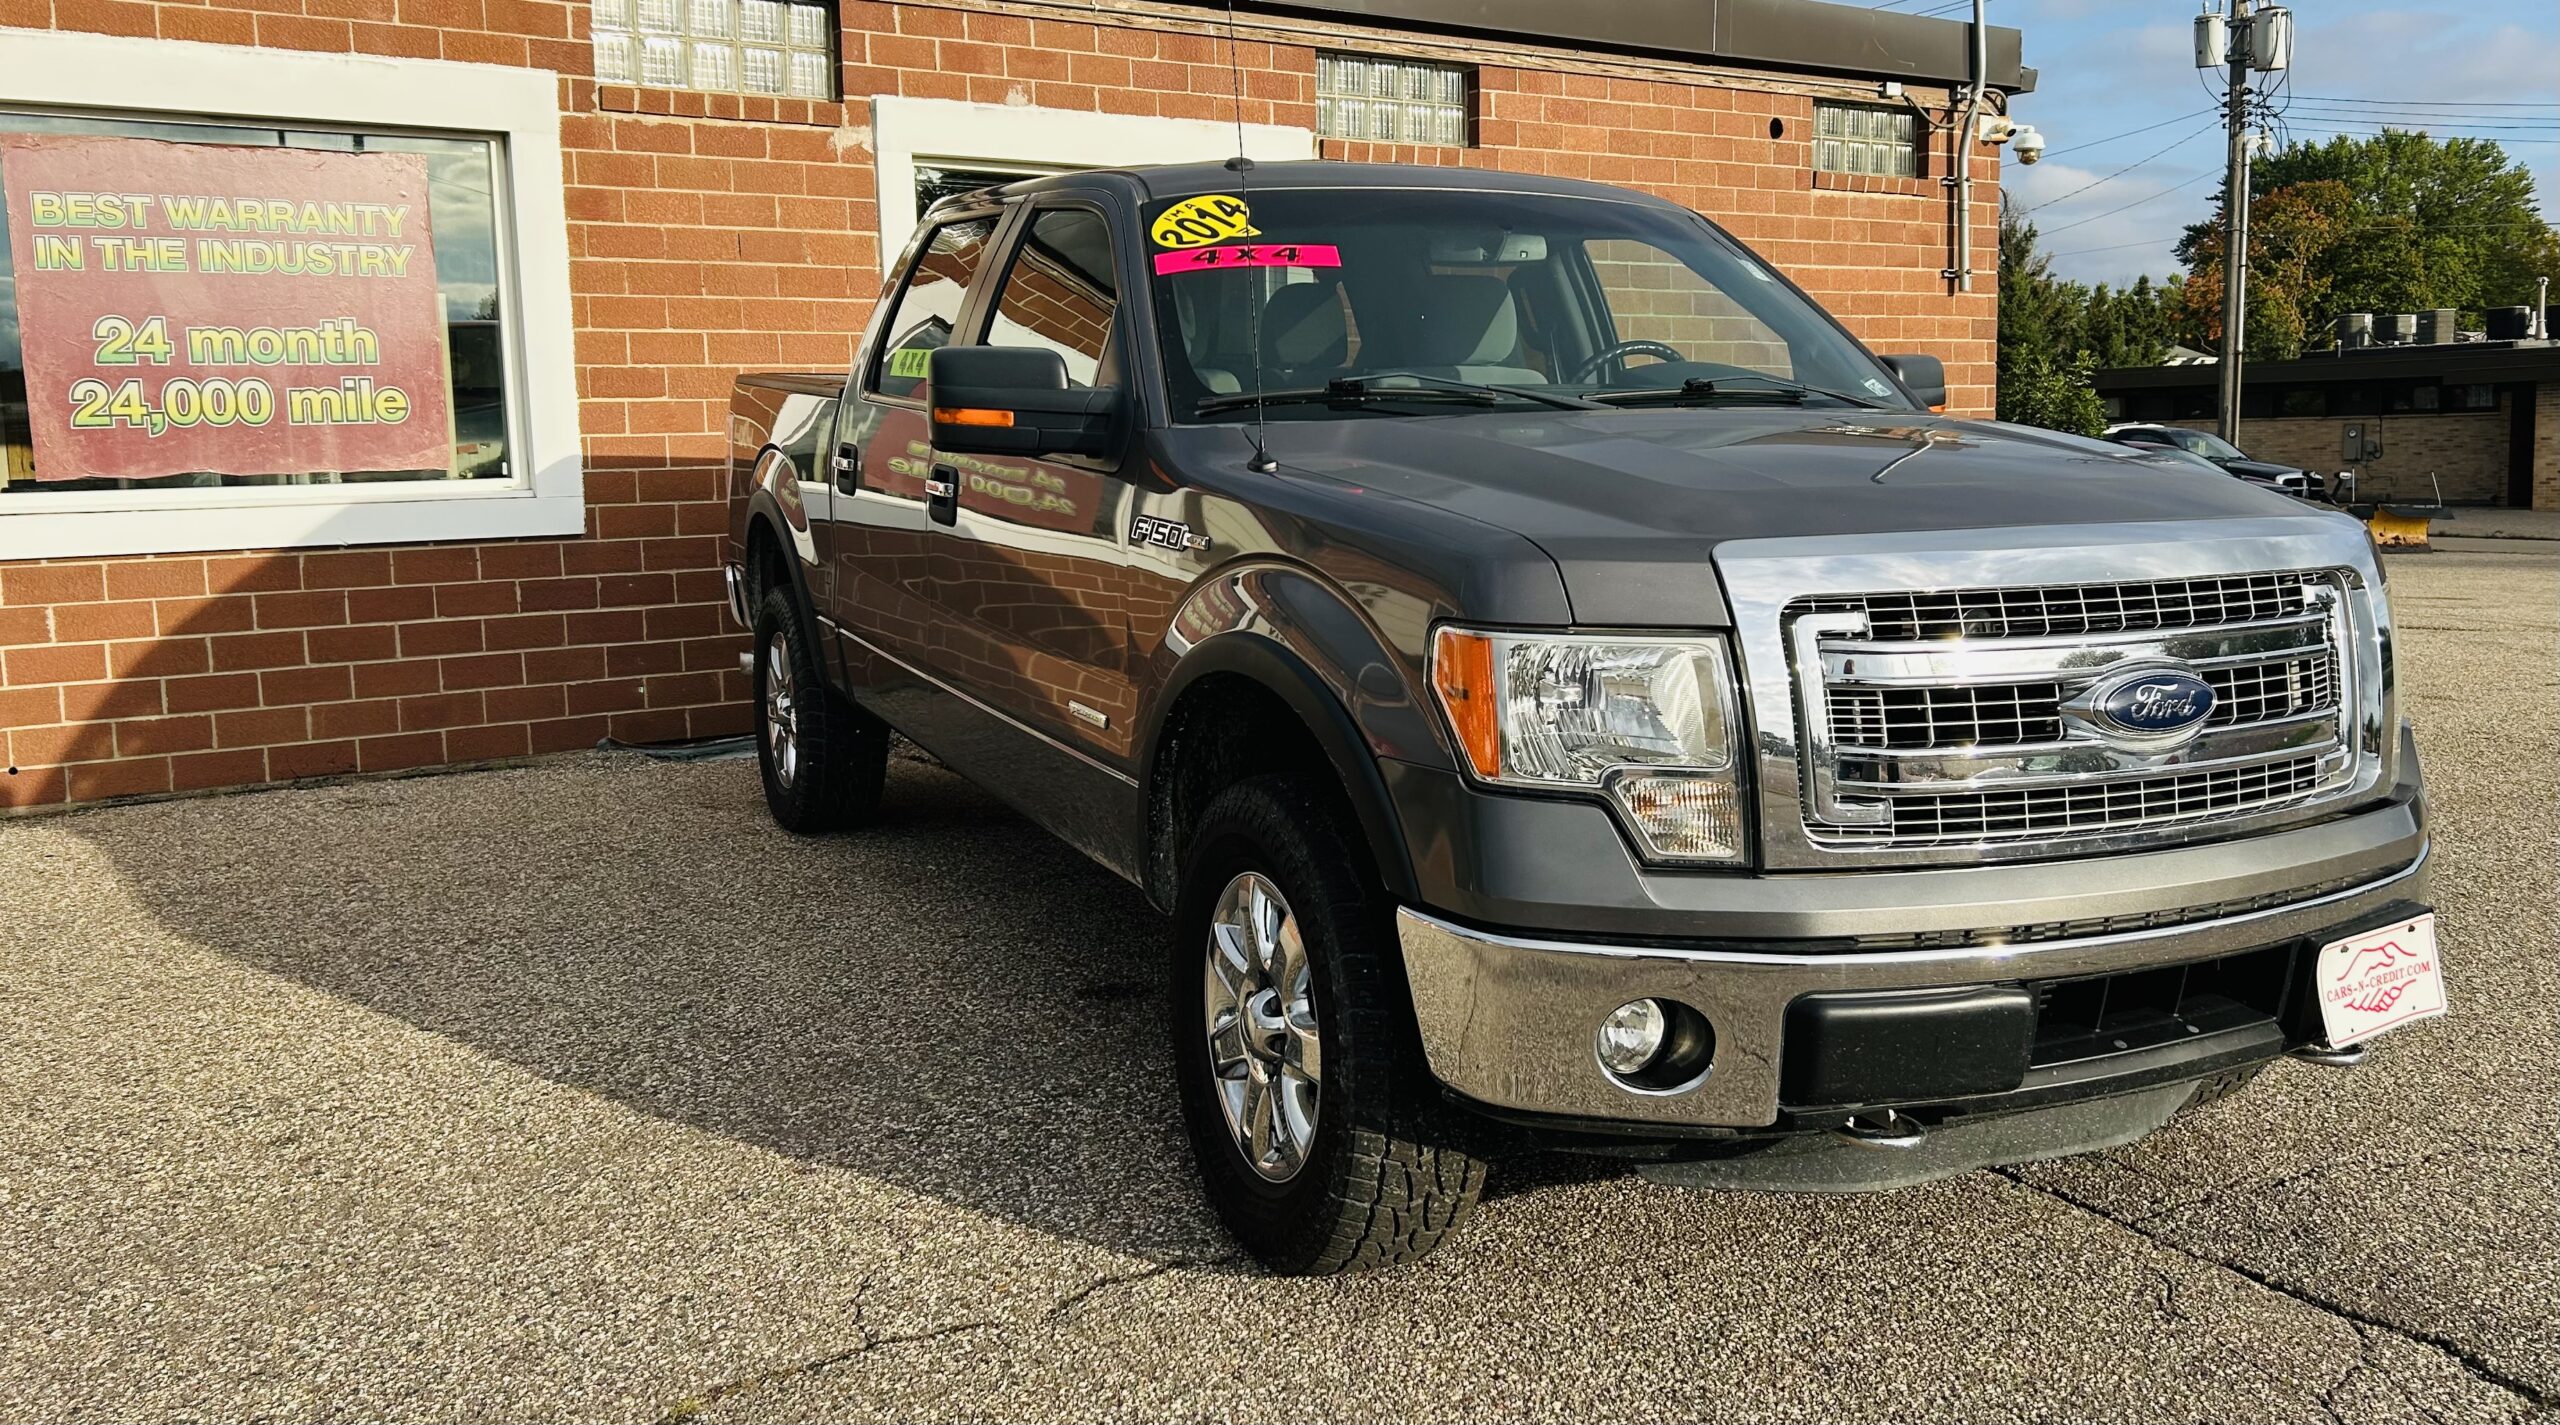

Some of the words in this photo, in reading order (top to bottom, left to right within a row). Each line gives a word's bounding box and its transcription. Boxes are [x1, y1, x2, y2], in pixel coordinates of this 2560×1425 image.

[30, 190, 153, 229] BEST
[160, 194, 410, 238] WARRANTY
[1160, 199, 1247, 245] 2014
[33, 235, 83, 271] IN
[92, 237, 188, 272] THE
[197, 239, 414, 277] INDUSTRY
[93, 314, 175, 366] 24
[186, 316, 380, 366] month
[69, 377, 274, 437] 24,000
[286, 377, 411, 425] mile
[1131, 516, 1184, 550] F-150
[2130, 683, 2197, 721] Ford
[2326, 961, 2431, 1003] CARS-N-CREDIT.COM
